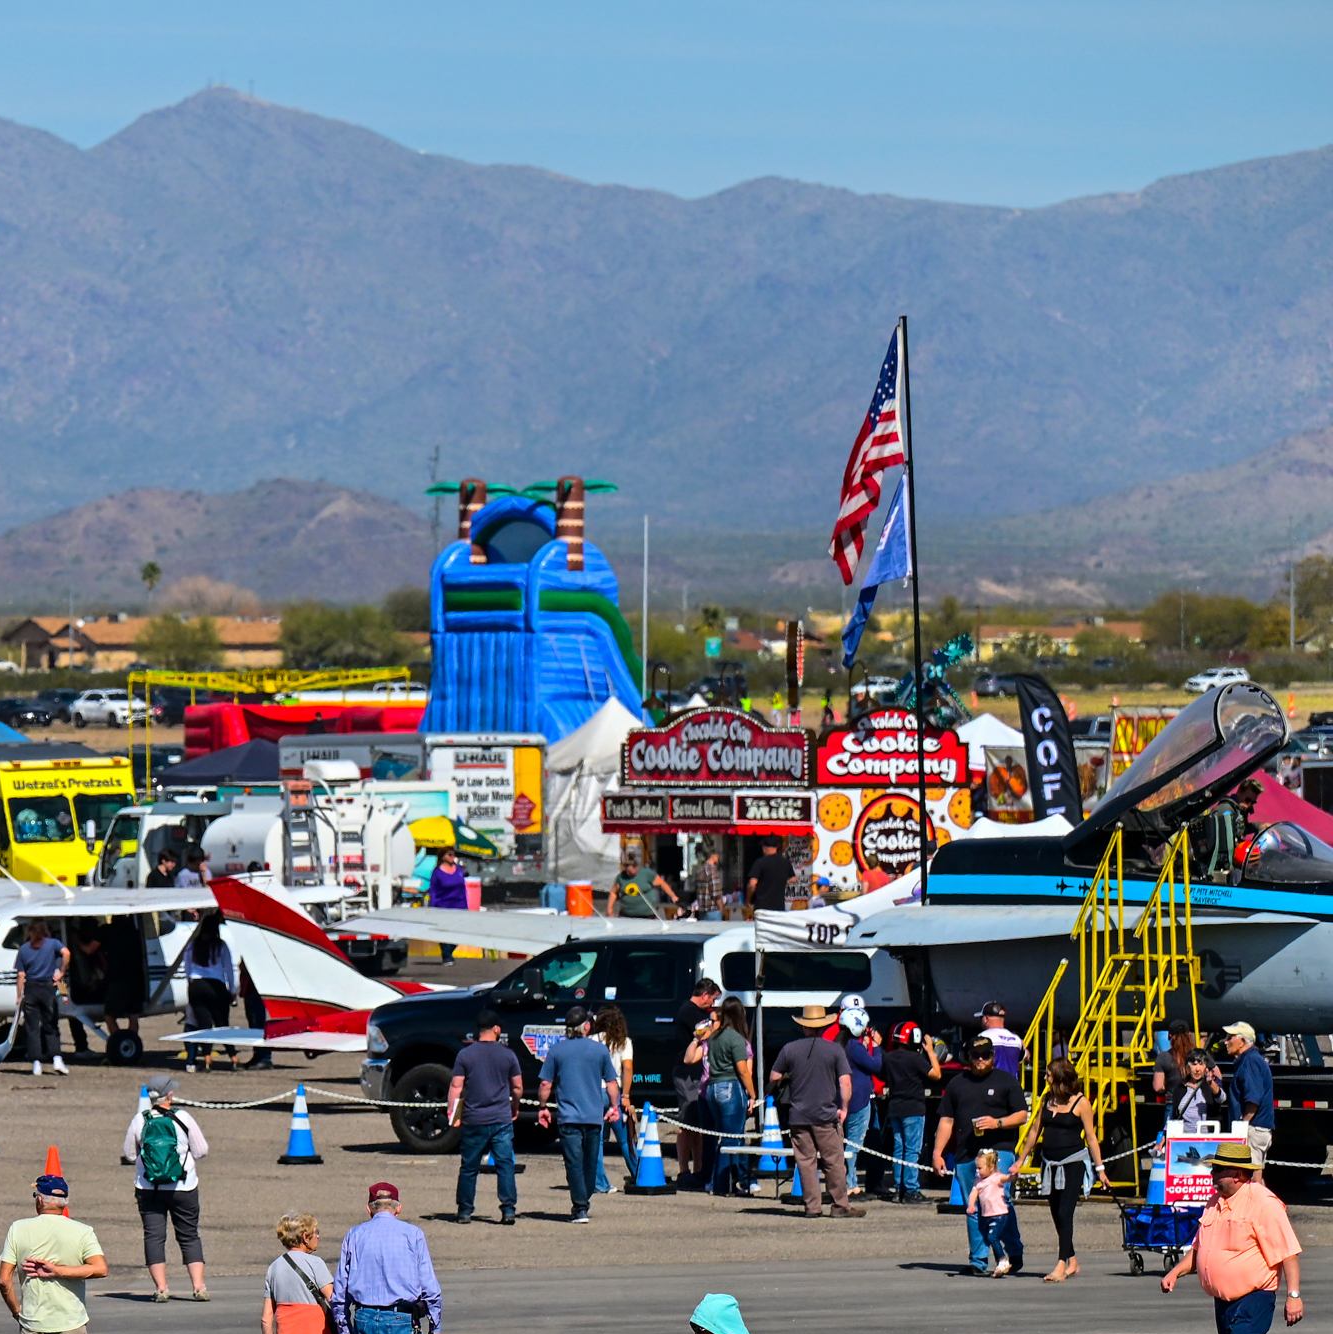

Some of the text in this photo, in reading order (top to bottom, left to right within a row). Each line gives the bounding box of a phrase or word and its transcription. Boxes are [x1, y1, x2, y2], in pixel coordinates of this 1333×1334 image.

[455, 752, 505, 763] U-HAUL
[631, 737, 803, 779] Cookie Company
[826, 731, 957, 784] Cookie Company
[472, 791, 489, 802] Your
[746, 806, 804, 820] Milk
[806, 923, 840, 945] TOP
[644, 1074, 662, 1083] HIRE
[1174, 1178, 1194, 1186] F-18
